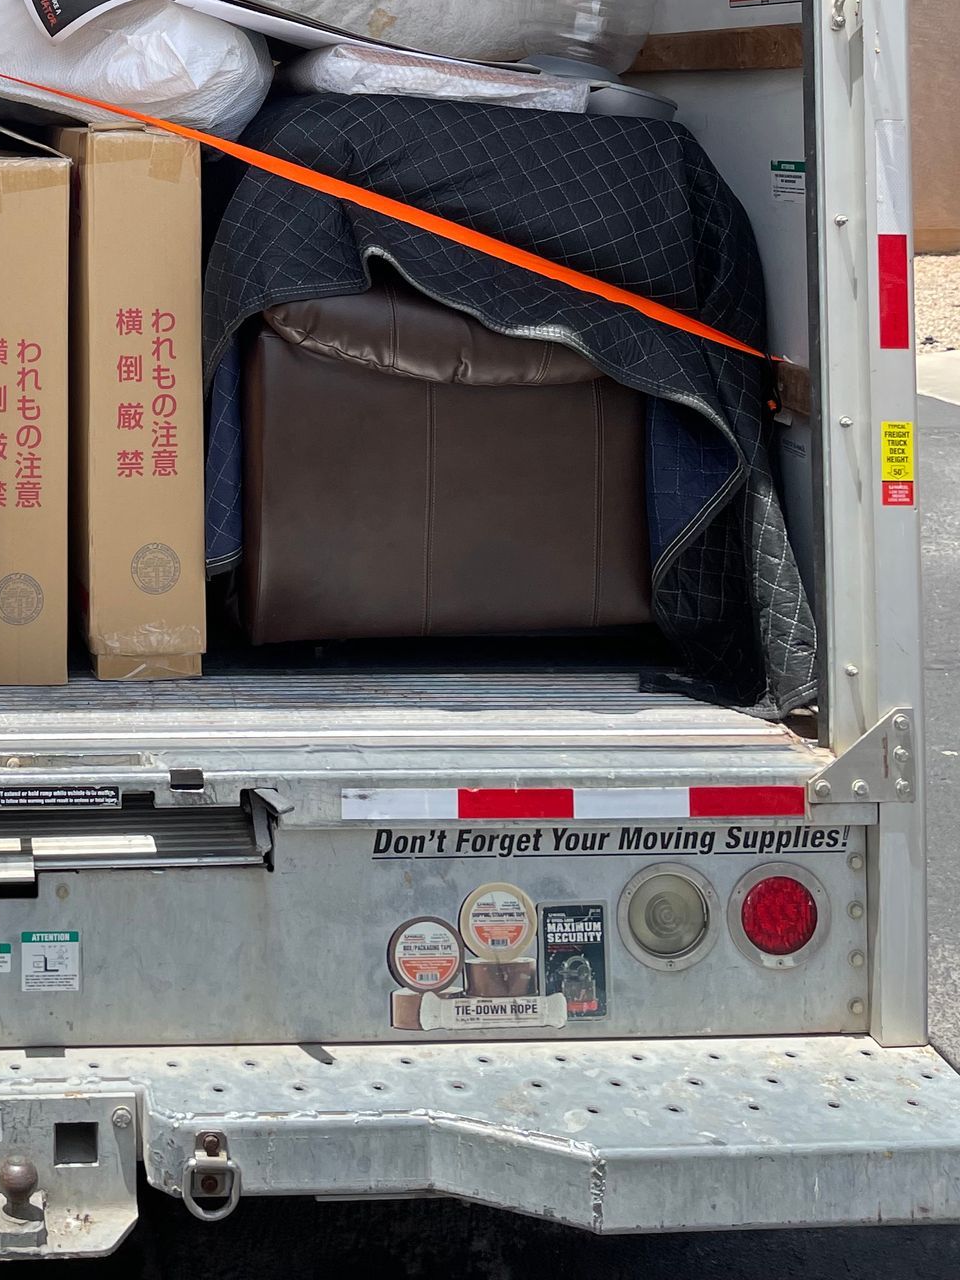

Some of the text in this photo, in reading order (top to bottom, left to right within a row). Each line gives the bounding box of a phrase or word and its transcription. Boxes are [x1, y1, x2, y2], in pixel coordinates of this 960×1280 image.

[116, 307, 144, 478] 横倒厳禁
[150, 307, 178, 477] われもの注意
[14, 338, 42, 509] われもの注意
[373, 825, 850, 857] Don't Forget Your Moving Supplies!
[32, 933, 70, 941] ATTENTION
[547, 922, 602, 932] MAXIMUM
[547, 932, 602, 943] SECURITY
[455, 1004, 538, 1015] TIE-DOWN ROPE
